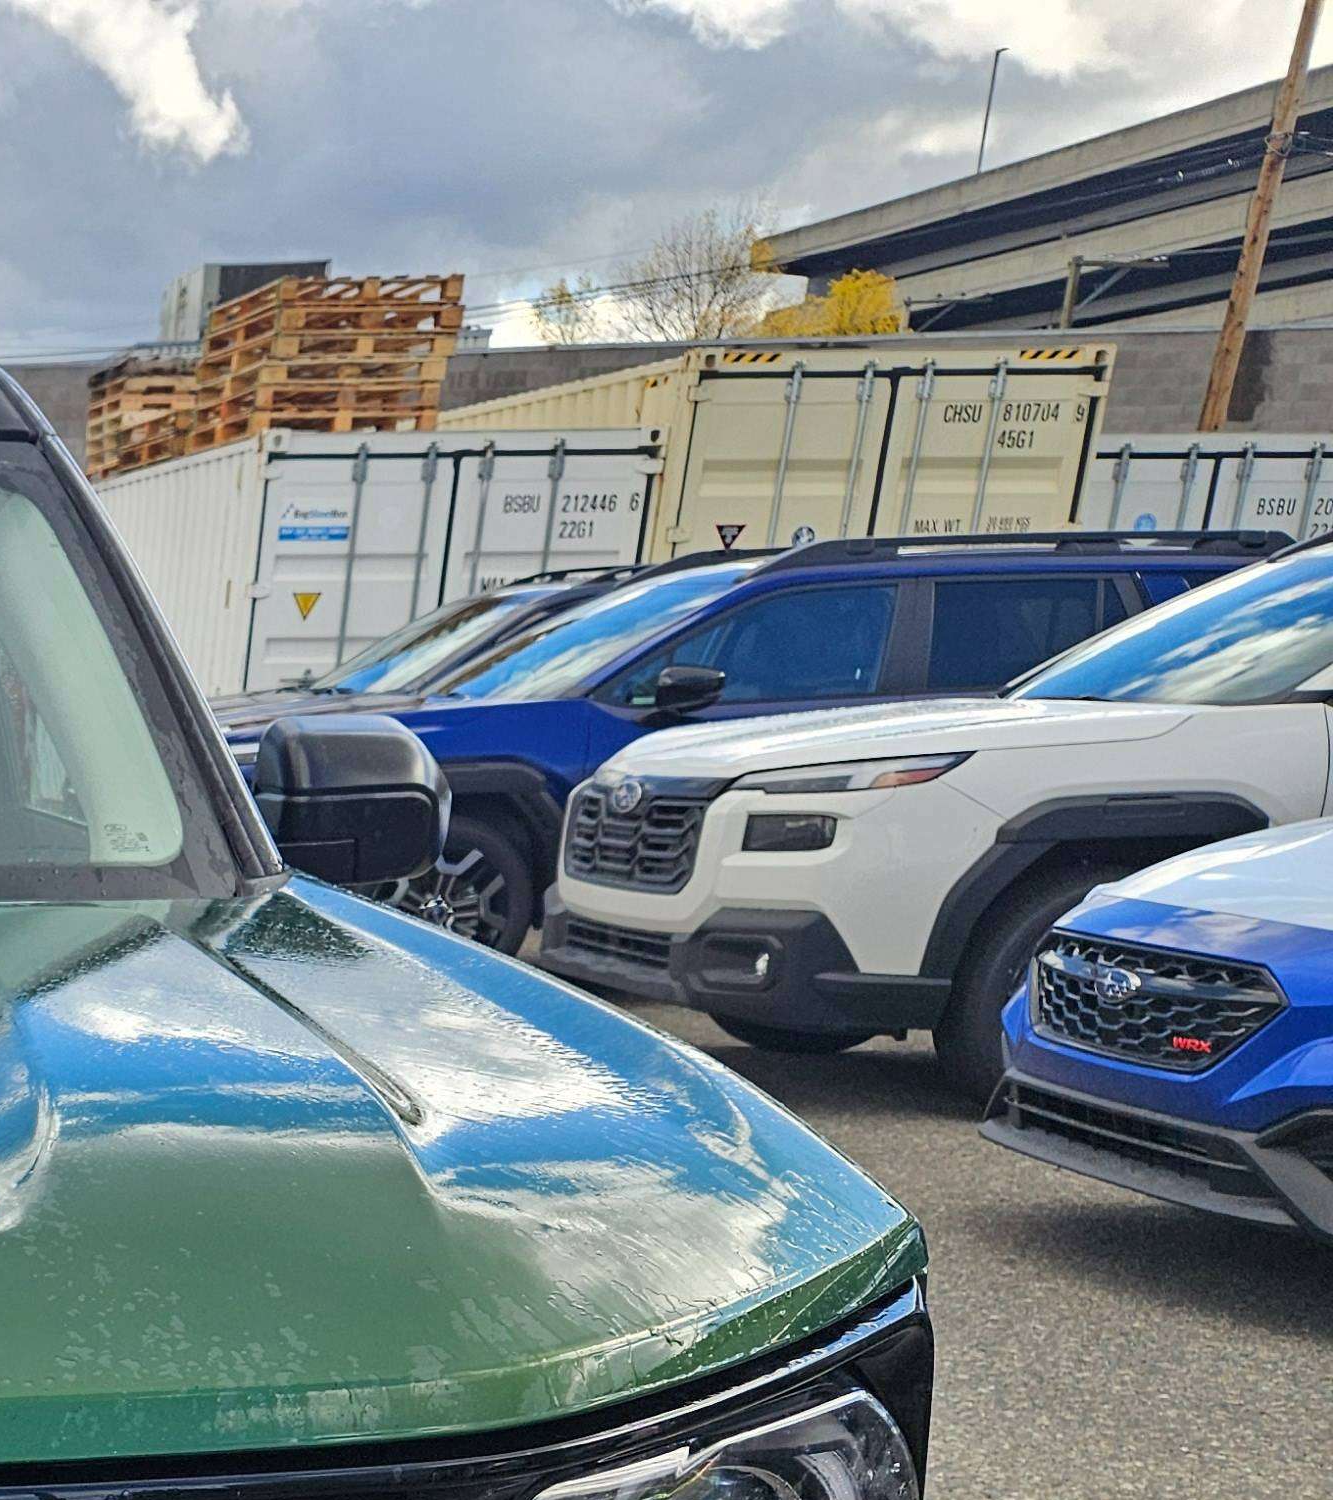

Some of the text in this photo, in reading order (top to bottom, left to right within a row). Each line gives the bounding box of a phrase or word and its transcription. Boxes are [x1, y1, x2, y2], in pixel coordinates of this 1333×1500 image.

[943, 404, 983, 423] CHSU
[1003, 403, 1060, 422] 810704
[997, 430, 1034, 449] 45G1
[503, 492, 640, 513] BSBU 212446 6
[1256, 498, 1296, 515] BSBU
[558, 520, 594, 539] 22G1
[1173, 1036, 1211, 1053] WRX
